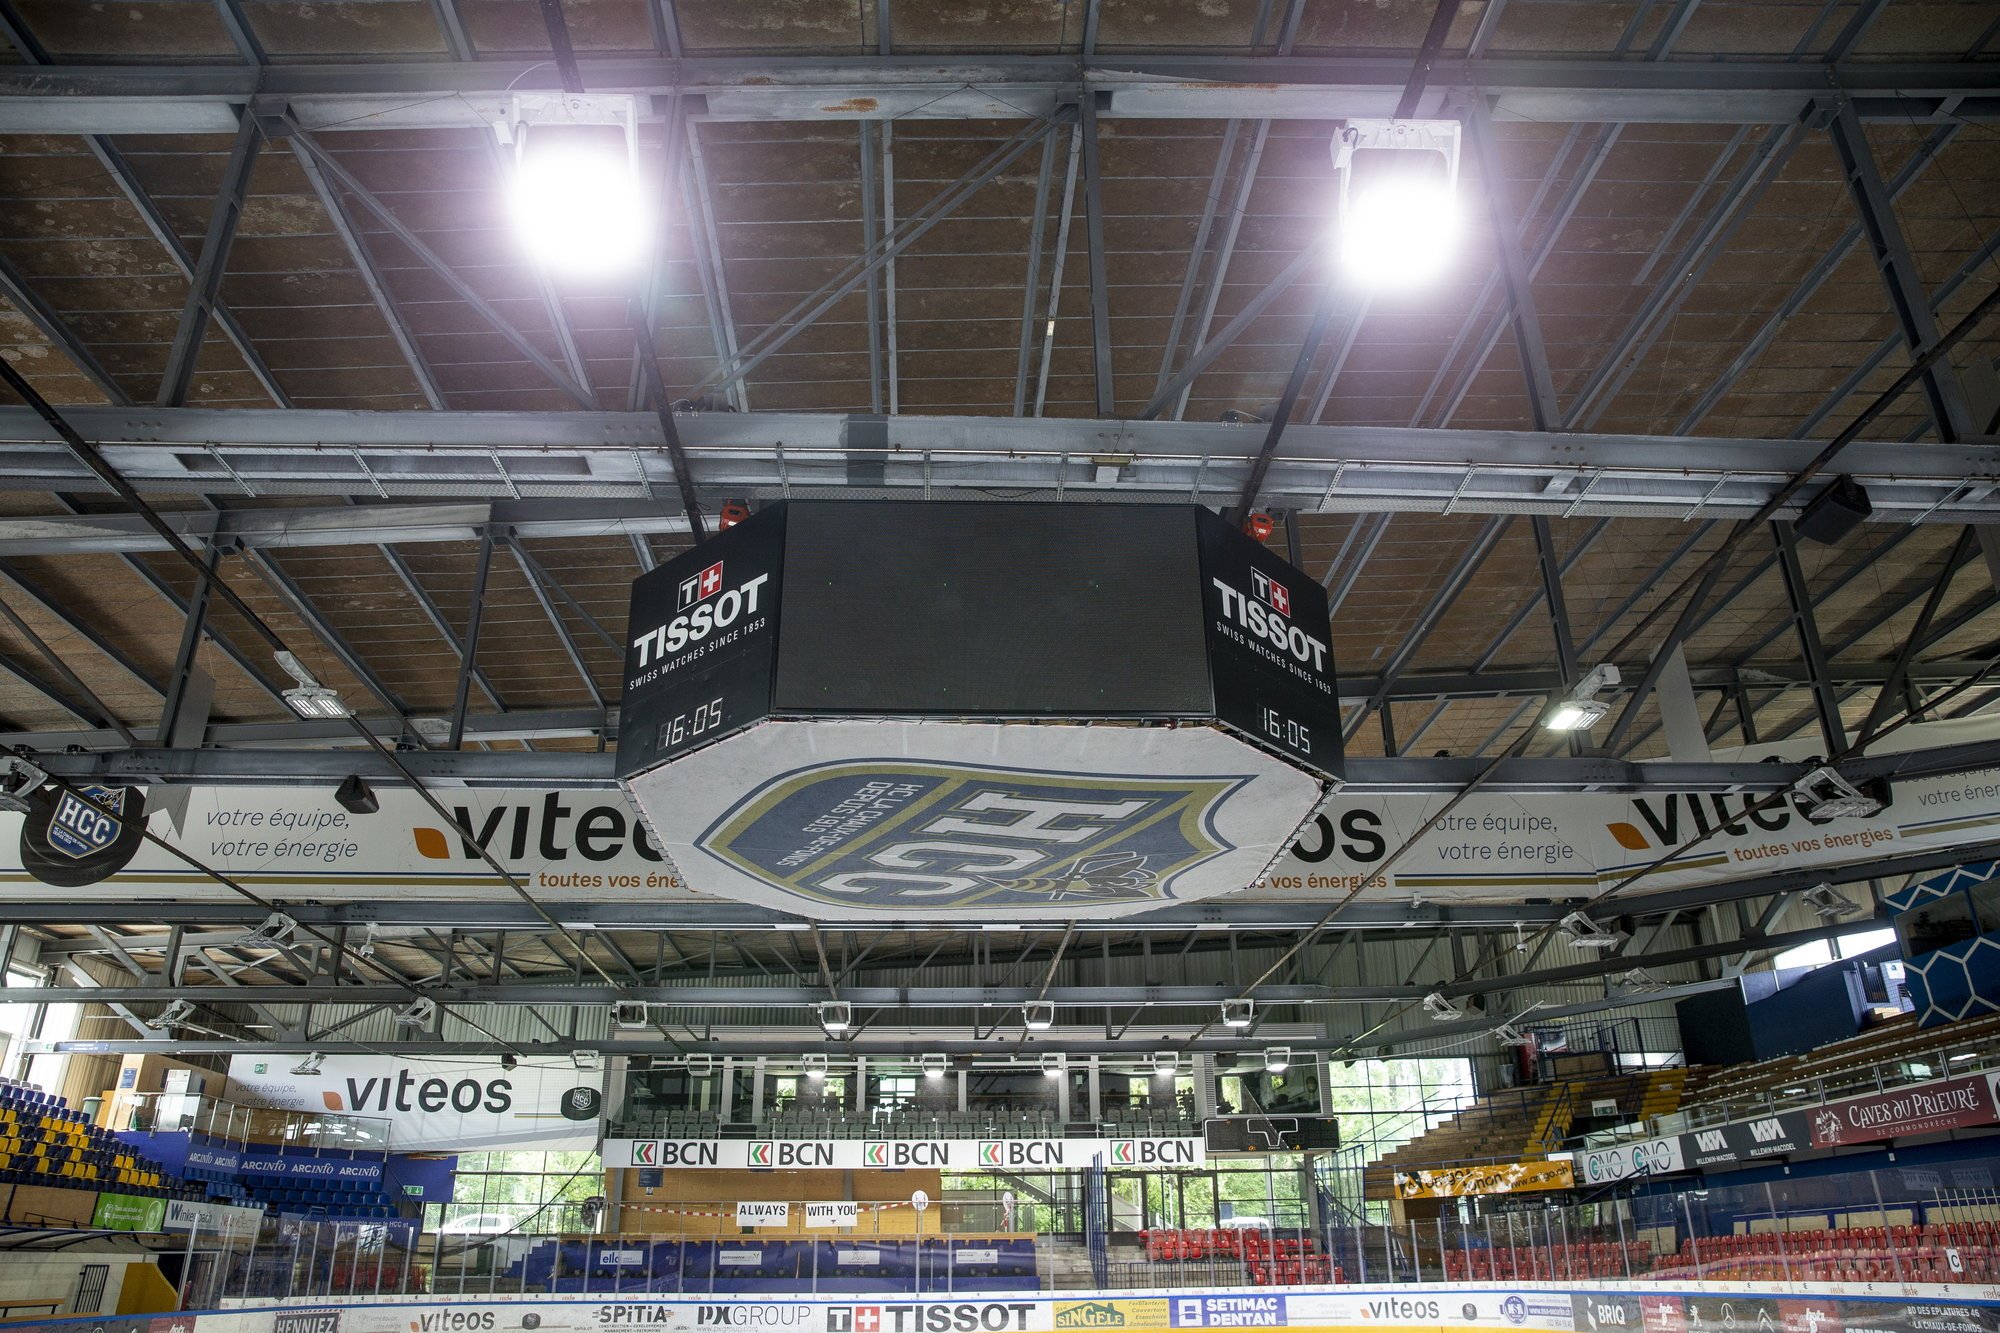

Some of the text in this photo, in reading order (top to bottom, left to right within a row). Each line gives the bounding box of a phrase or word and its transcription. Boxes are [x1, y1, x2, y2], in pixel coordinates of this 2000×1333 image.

[633, 573, 769, 668] TISSOT
[1213, 577, 1327, 673] TISSOT
[629, 617, 766, 690] SWISS WATCHES SINCE 1853
[1216, 621, 1332, 695] SWISS WATCHES SINCE 1853
[665, 697, 723, 747] 16:05
[1263, 707, 1311, 755] 16:05
[1917, 789, 1962, 807] votre
[59, 797, 111, 845] HCC
[207, 808, 350, 832] votre équipe,
[1482, 812, 1559, 834] équipe,
[211, 838, 359, 863] votre énergie
[818, 792, 1150, 896] HCC
[1437, 840, 1575, 865] votre énergie
[1733, 826, 1895, 862] toutes vos énergies
[538, 872, 603, 888] toutes
[608, 874, 642, 888] vos
[1270, 876, 1302, 889] vos
[1307, 872, 1388, 893] énergies
[235, 1082, 297, 1095] votre équipe,
[346, 1069, 512, 1114] viteos
[574, 1092, 589, 1105] HCC
[241, 1096, 305, 1108] votre énergie
[1849, 1101, 1892, 1129] CAVES
[1876, 1129, 1886, 1137] DE
[662, 1140, 1195, 1166] BCN BCN BCN BCN BCN
[739, 1204, 786, 1216] ALWAYS
[807, 1204, 857, 1217] WITH YOU
[1951, 1254, 1960, 1268] C
[1206, 1298, 1278, 1312] SETIMAC
[1369, 1297, 1440, 1319] viteos
[1597, 1305, 1626, 1325] BRIQ
[1917, 1307, 1931, 1315] DES
[1931, 1307, 1970, 1317] EPLATURES
[1971, 1308, 1981, 1318] 46
[277, 1317, 335, 1333] HENNIEZ
[420, 1308, 495, 1332] viteos
[885, 1303, 1036, 1332] TISSOT
[1210, 1312, 1276, 1326] DENTAN
[1914, 1321, 1983, 1333] LA CHAUX-DE-FONDS
